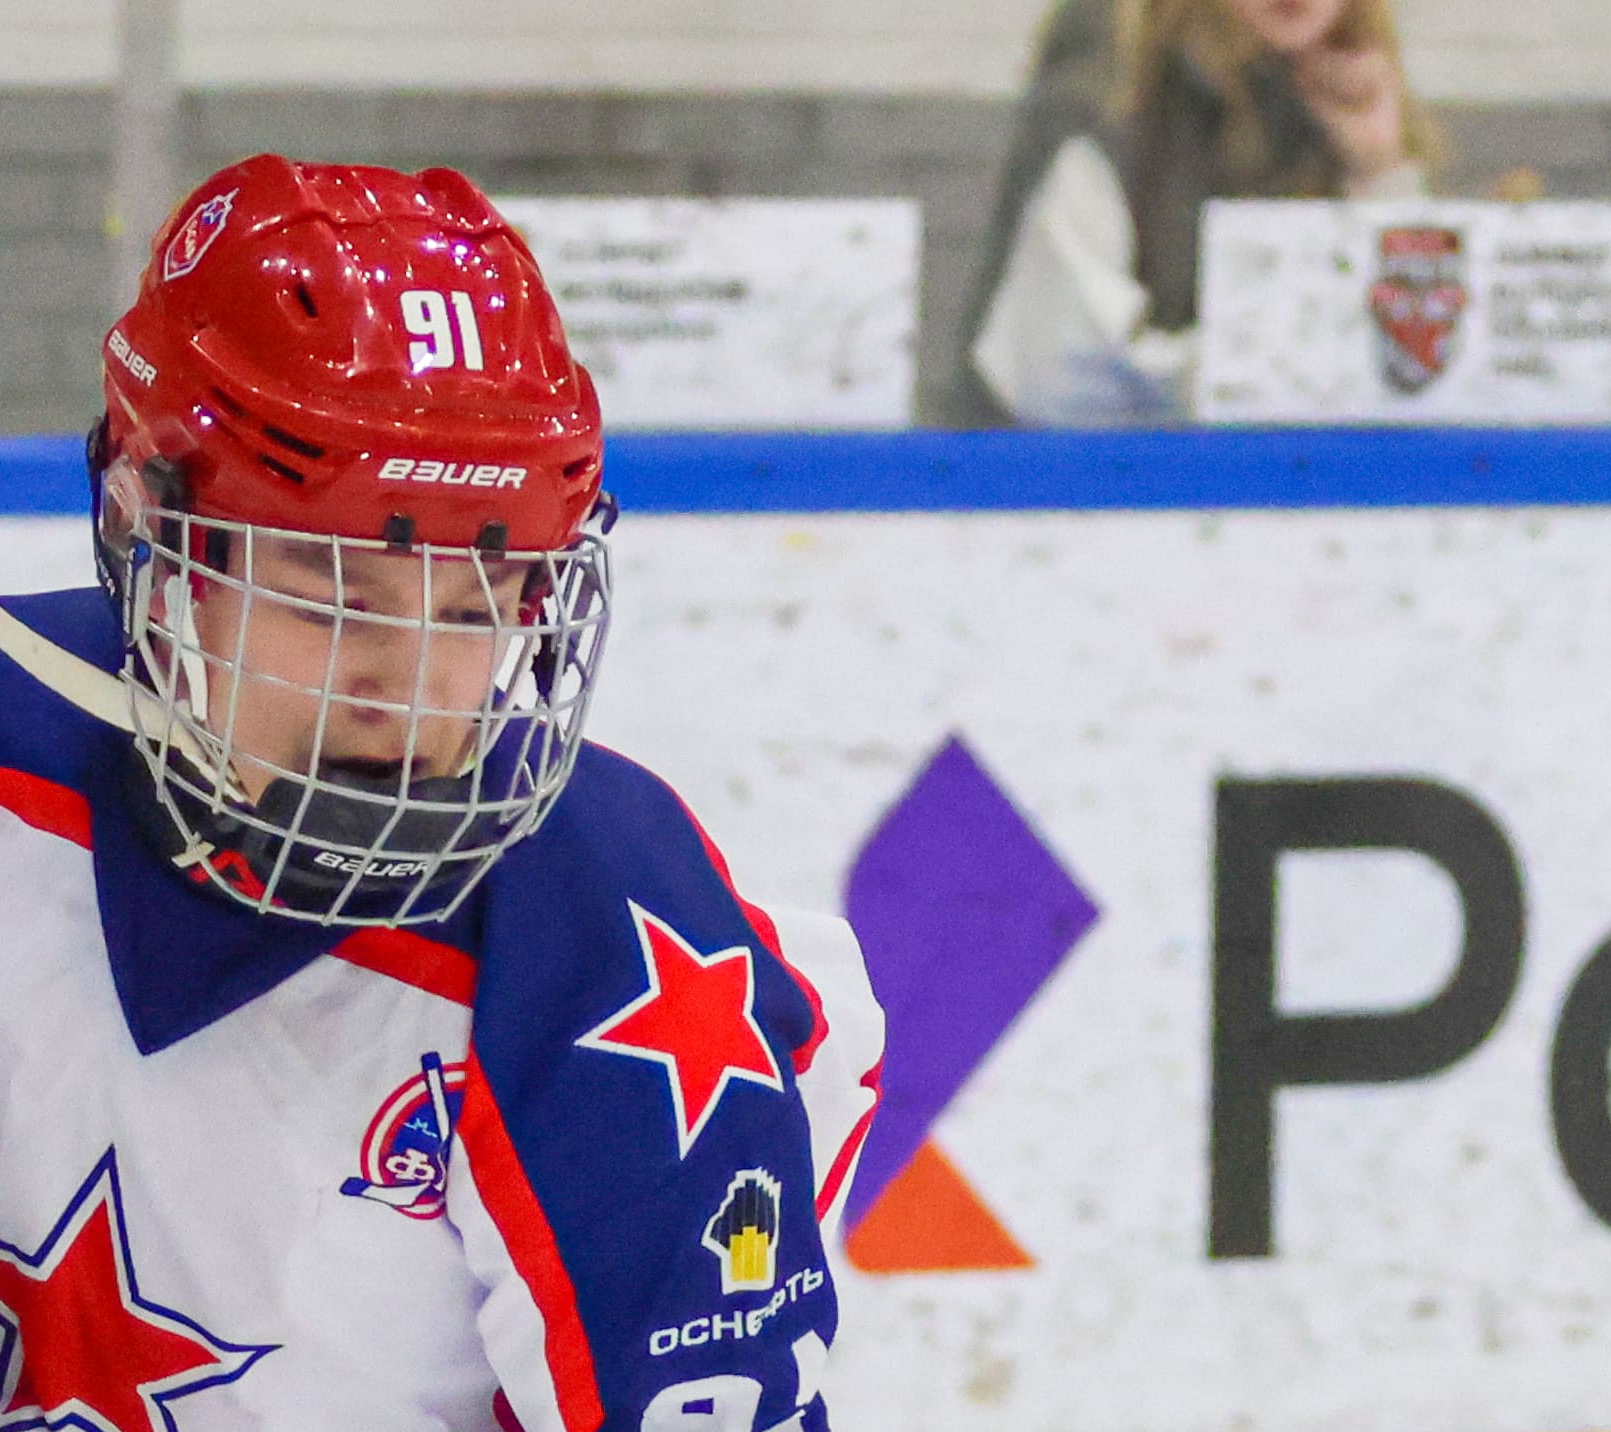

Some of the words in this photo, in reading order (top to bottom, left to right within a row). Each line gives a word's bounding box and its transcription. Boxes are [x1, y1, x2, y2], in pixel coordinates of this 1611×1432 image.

[108, 329, 158, 387] BAUER
[399, 289, 484, 371] 91
[377, 457, 528, 490] BAUER
